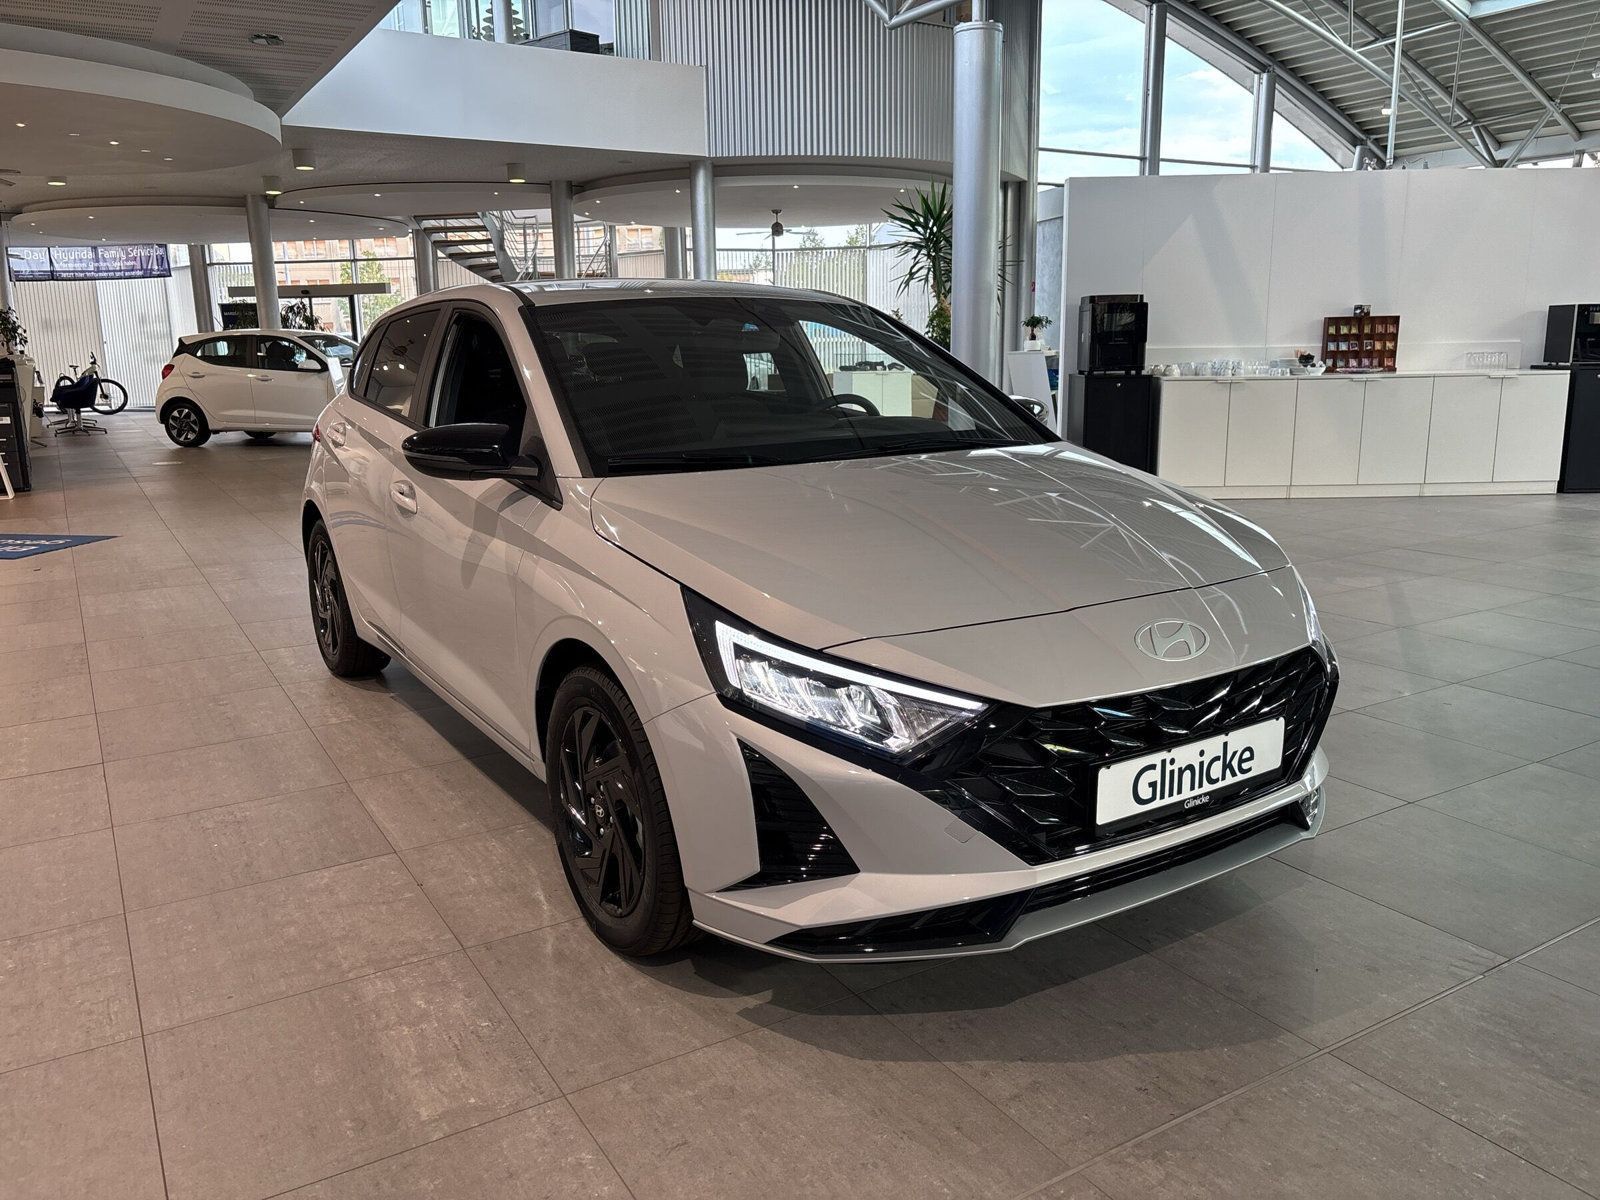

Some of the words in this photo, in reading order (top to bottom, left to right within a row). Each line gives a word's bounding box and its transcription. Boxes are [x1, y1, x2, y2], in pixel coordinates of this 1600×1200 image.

[54, 248, 95, 260] Hyundai
[98, 248, 126, 260] Family
[127, 246, 153, 257] Service
[1132, 741, 1255, 806] Glinicke
[1184, 795, 1210, 809] Glinicke
